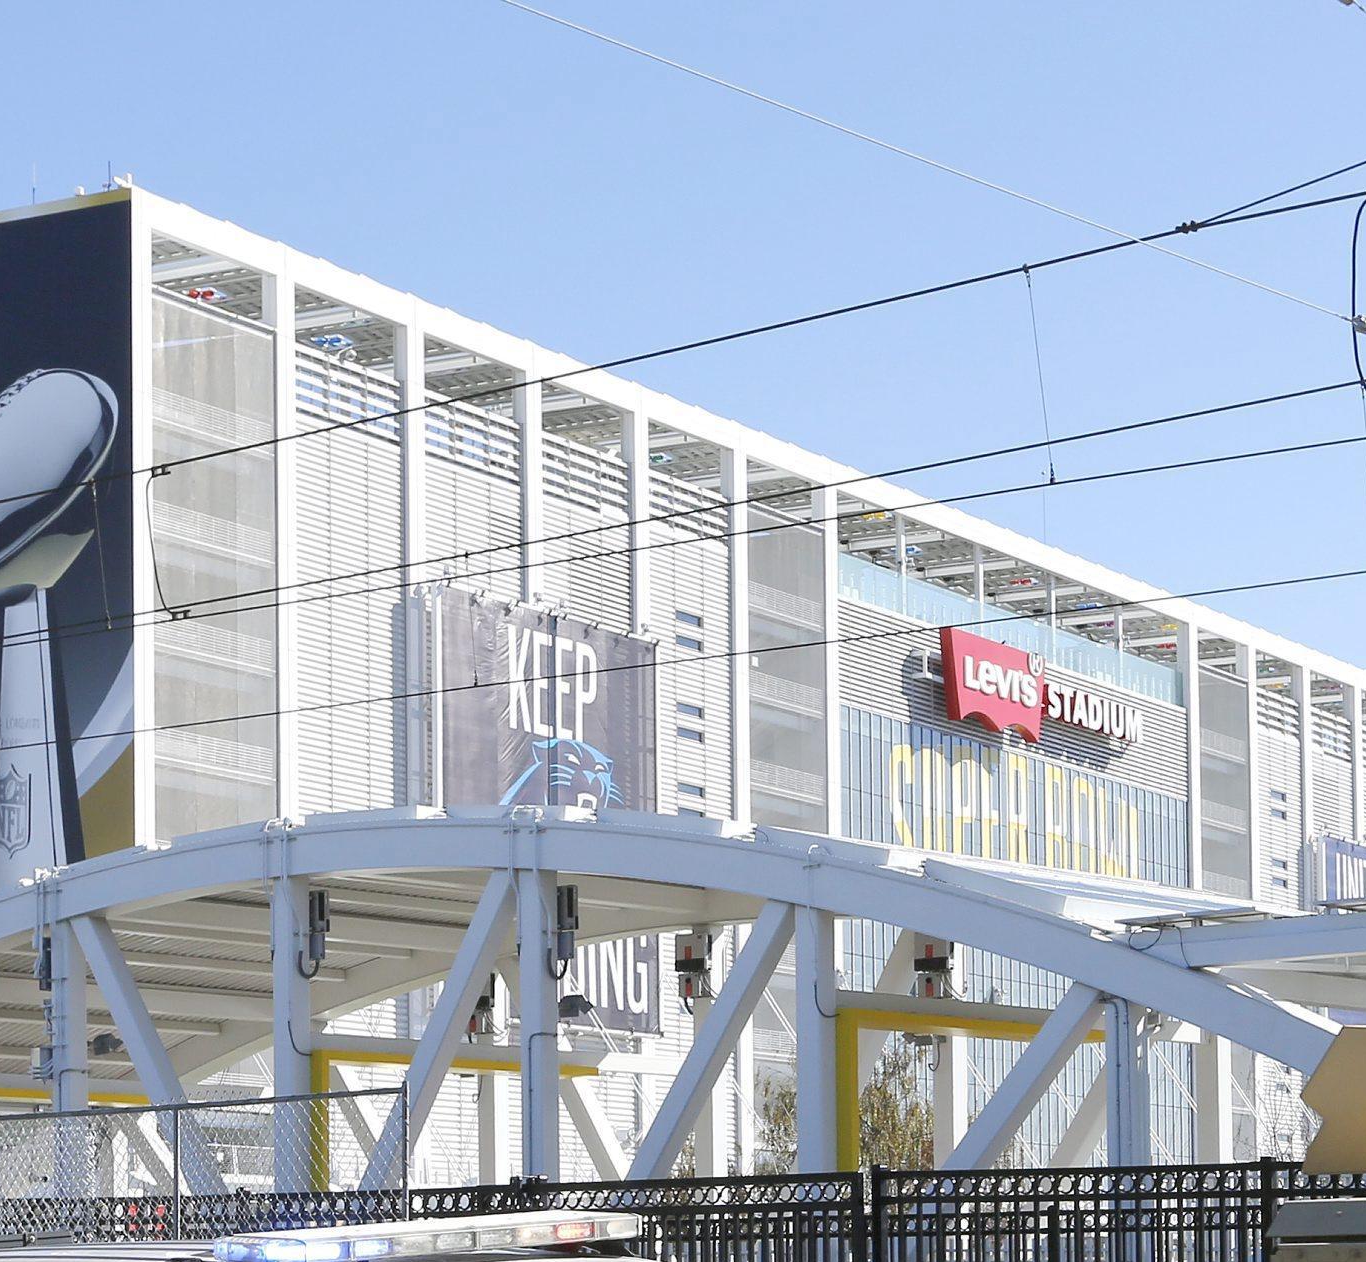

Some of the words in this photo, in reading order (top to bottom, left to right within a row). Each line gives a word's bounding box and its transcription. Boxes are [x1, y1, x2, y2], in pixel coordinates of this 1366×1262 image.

[507, 623, 599, 742] KEEP
[1047, 682, 1143, 744] STADIUM
[890, 743, 1029, 864] SUPER
